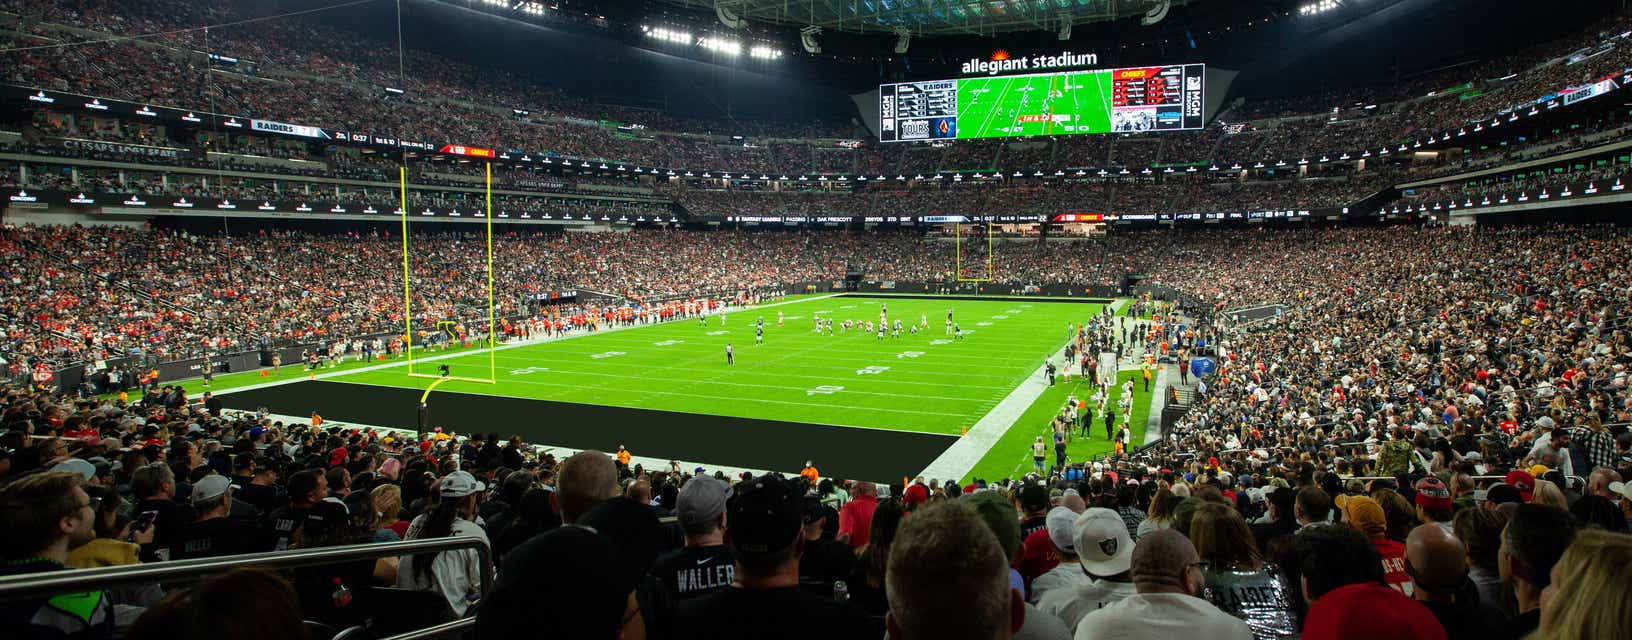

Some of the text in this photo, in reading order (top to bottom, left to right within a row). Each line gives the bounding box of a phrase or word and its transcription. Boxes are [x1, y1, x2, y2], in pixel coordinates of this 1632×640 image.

[962, 52, 1097, 75] allegiant stadium
[882, 95, 890, 118] MGM
[1191, 91, 1200, 117] MGM
[257, 122, 294, 133] RAIDERS
[902, 123, 929, 134] TOURS
[677, 564, 735, 593] WALLER
